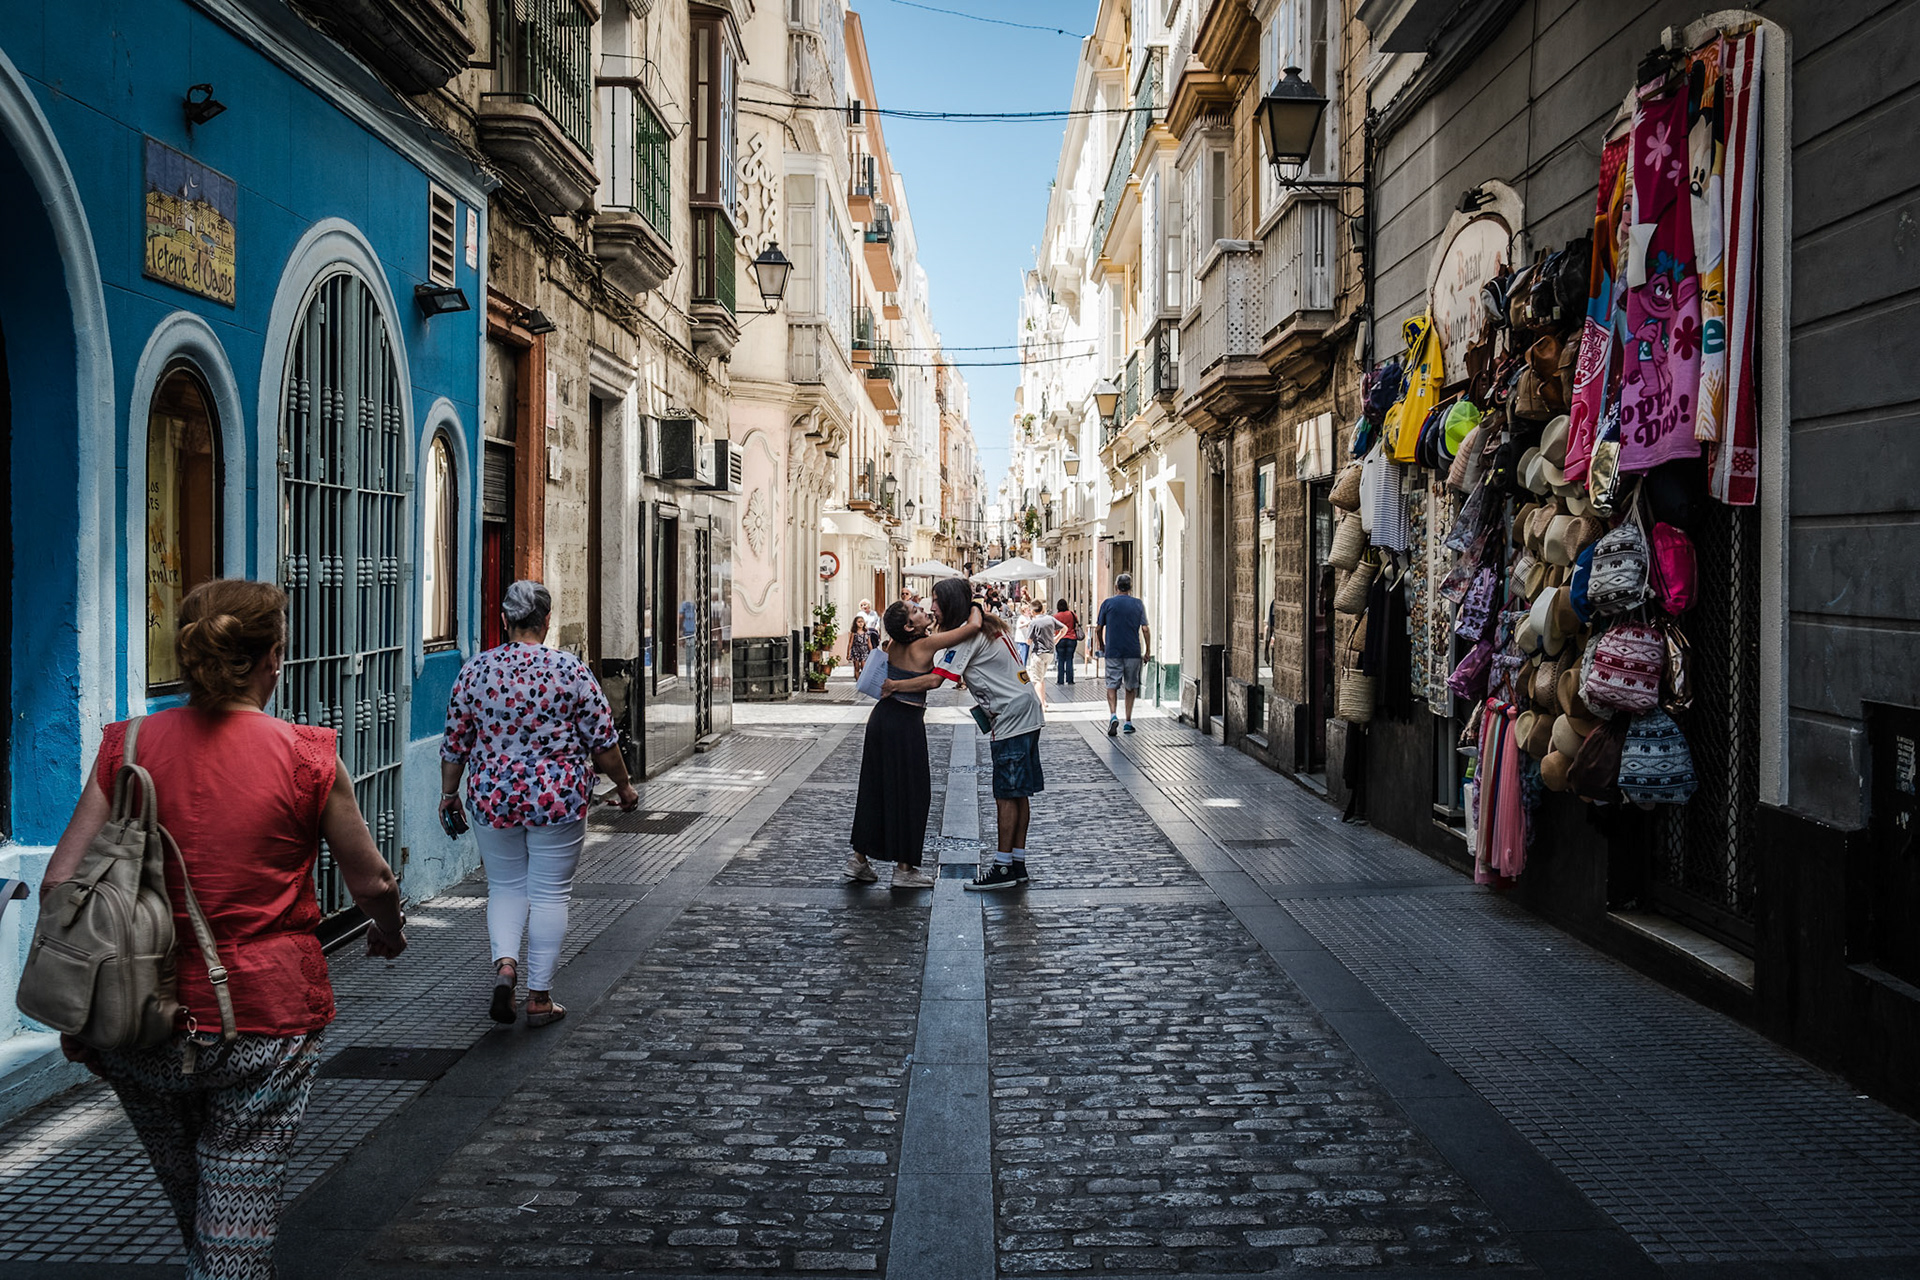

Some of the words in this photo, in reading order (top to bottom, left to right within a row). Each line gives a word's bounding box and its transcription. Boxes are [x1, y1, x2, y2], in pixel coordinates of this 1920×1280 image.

[192, 249, 201, 286] el
[204, 259, 232, 297] Oasis
[1634, 394, 1691, 448] Day!
